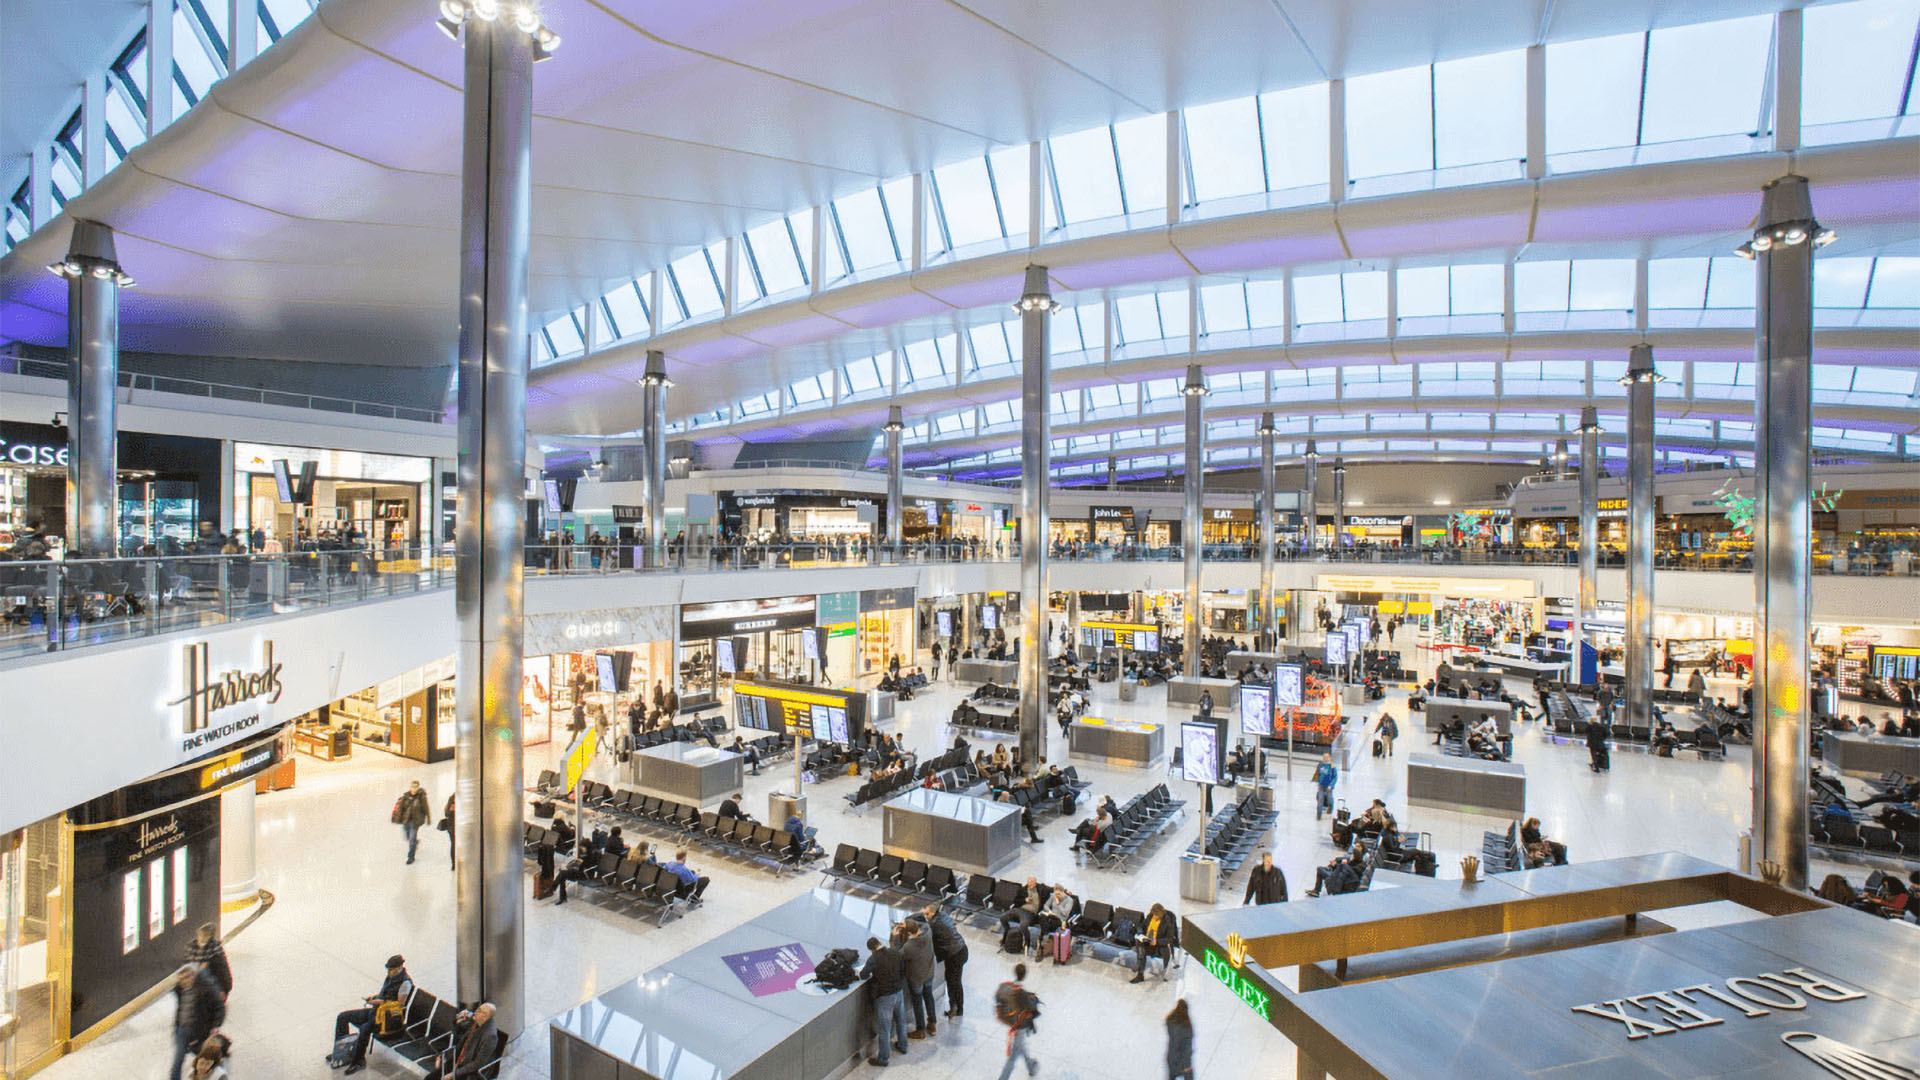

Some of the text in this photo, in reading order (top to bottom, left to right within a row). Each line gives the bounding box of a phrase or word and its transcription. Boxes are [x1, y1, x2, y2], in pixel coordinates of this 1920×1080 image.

[0, 438, 68, 466] ase
[1094, 509, 1110, 519] John
[566, 621, 621, 638] GUCCI
[166, 640, 282, 733] Harrods
[183, 714, 259, 752] FINE WATCH ROOM
[136, 814, 178, 849] Harrods
[1204, 948, 1270, 1021] ROLEX
[1570, 967, 1867, 1040] ROLEX
